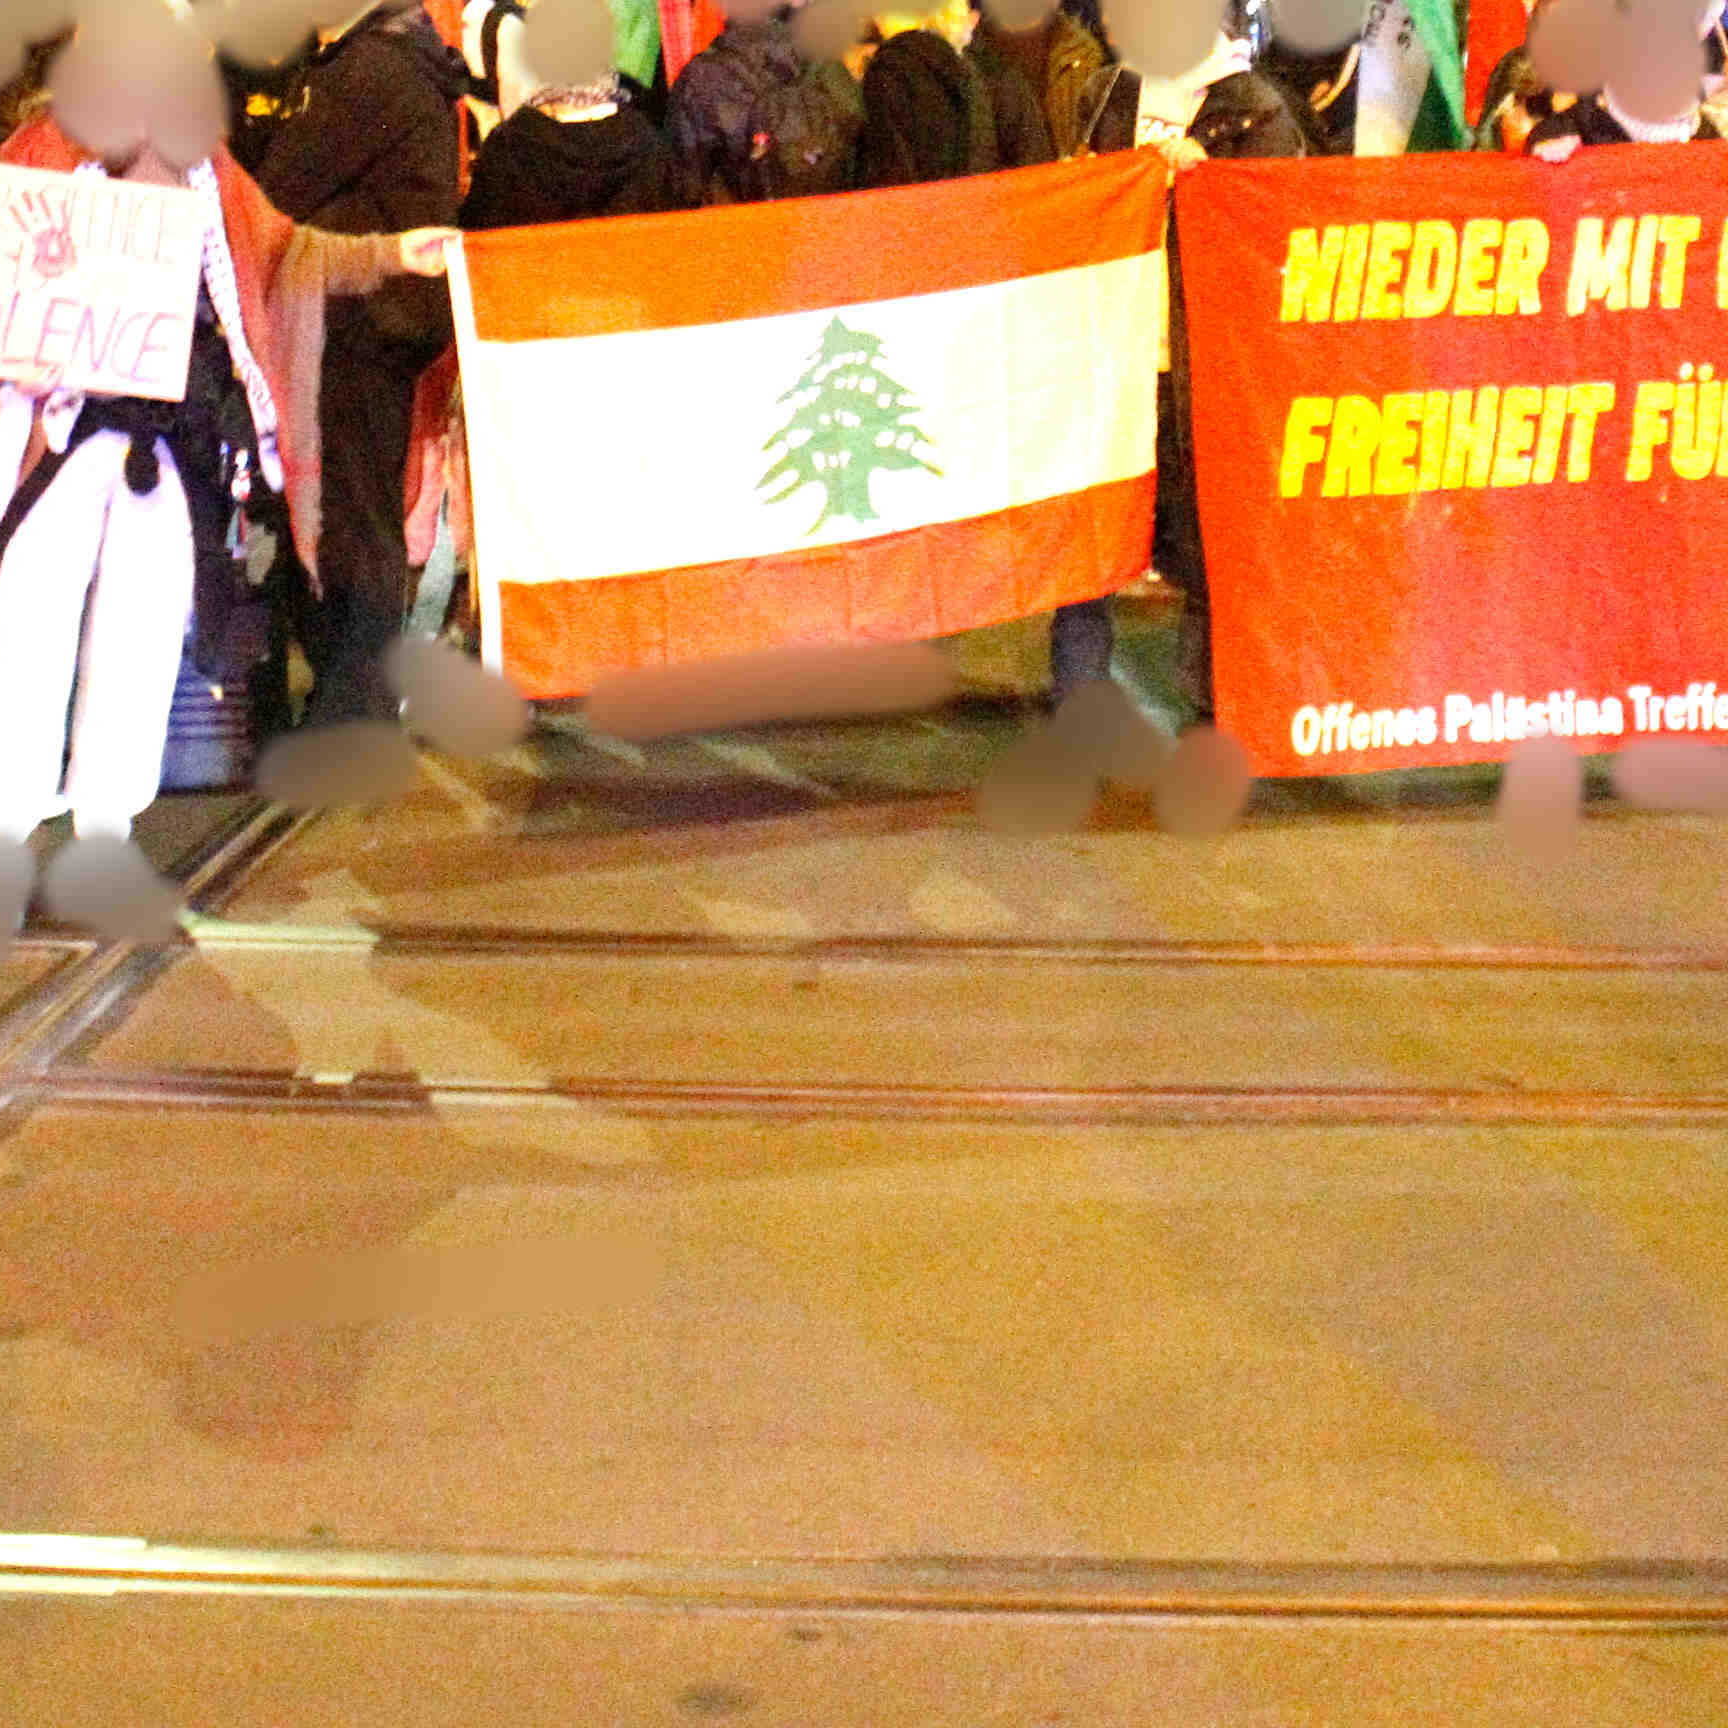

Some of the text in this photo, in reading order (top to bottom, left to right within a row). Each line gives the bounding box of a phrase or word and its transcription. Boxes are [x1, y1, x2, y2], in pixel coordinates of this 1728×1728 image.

[1280, 218, 1550, 323] NIEDER
[1566, 215, 1702, 317] MIT
[1280, 382, 1615, 498] FREIHEIT
[1290, 702, 1437, 758] Offenes
